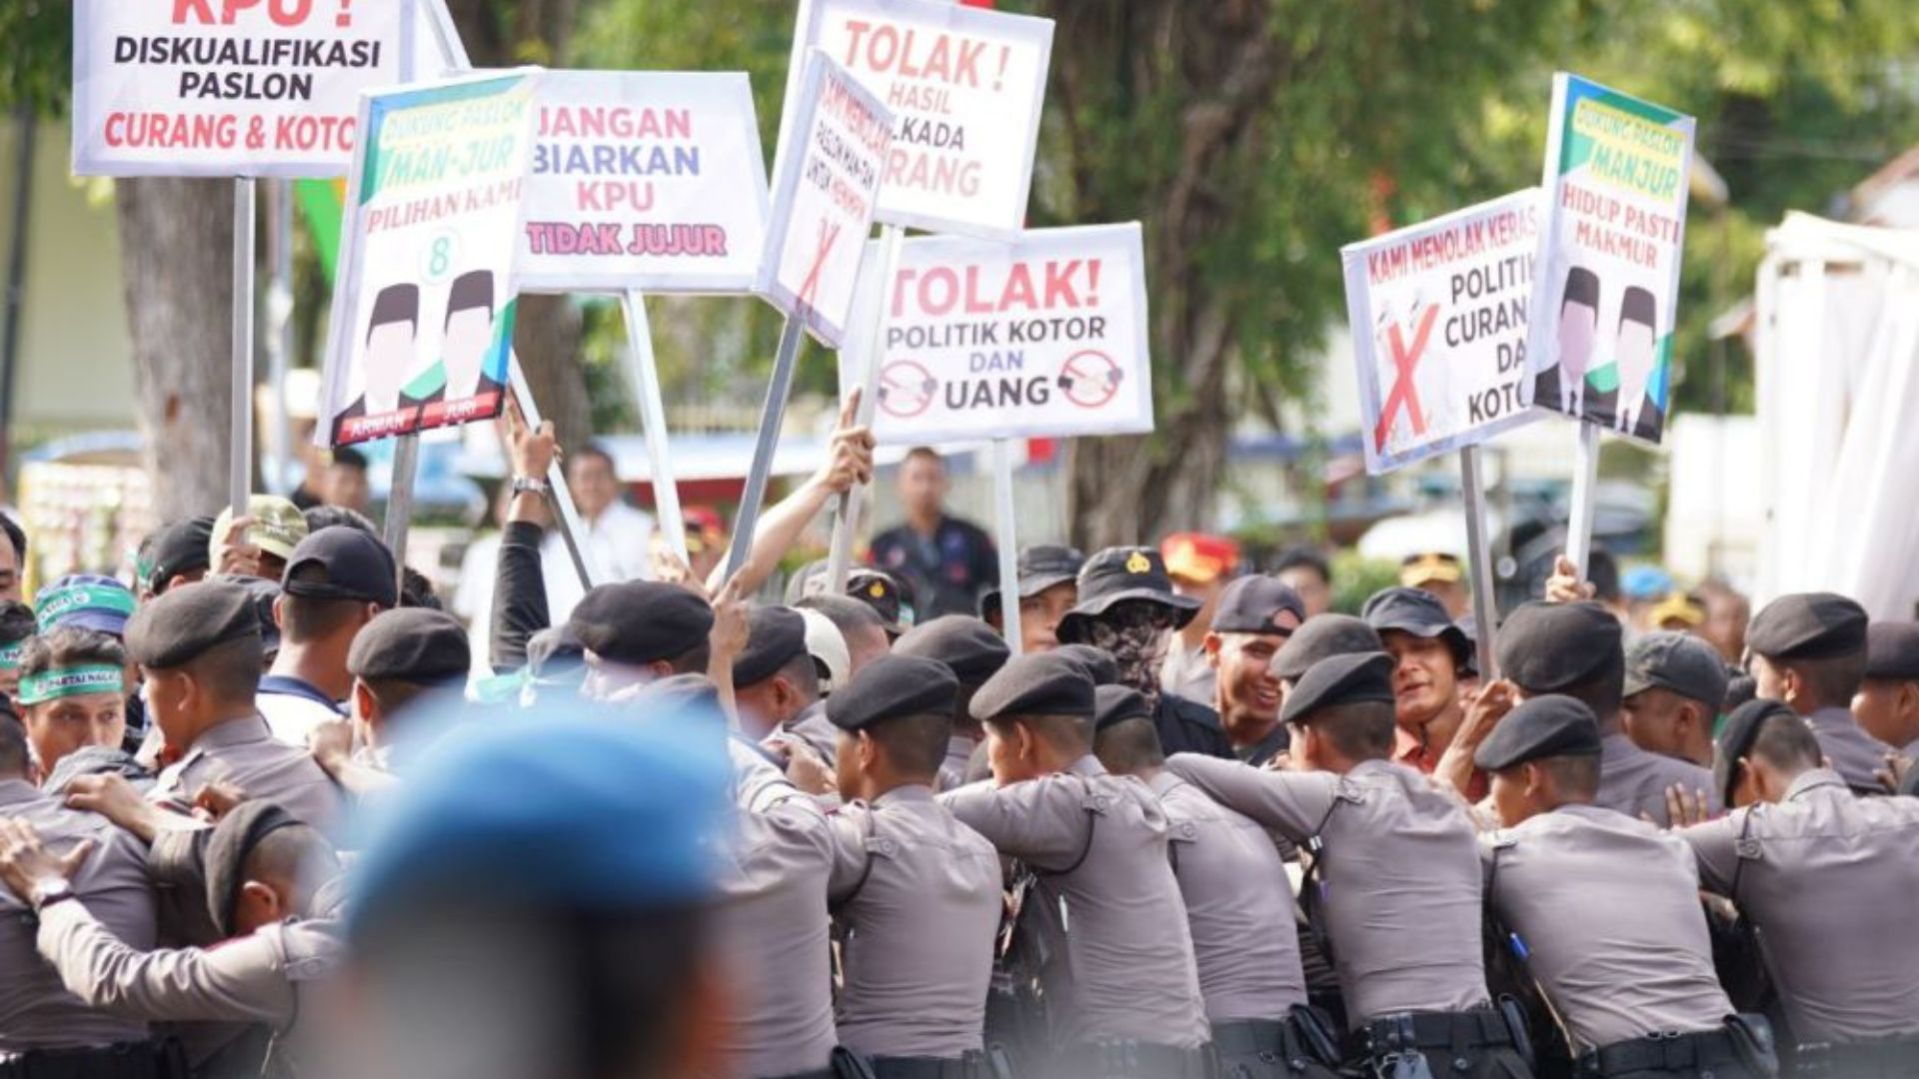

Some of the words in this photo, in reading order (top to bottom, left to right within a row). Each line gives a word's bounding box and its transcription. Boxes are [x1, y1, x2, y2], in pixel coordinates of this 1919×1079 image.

[114, 36, 380, 68] DISKUALIFIKASI
[844, 20, 986, 88] TOLAK
[993, 47, 1011, 92] !
[179, 71, 313, 100] PASLON
[888, 82, 952, 115] HASIL
[105, 112, 237, 149] CURANG
[245, 115, 265, 150] &
[537, 107, 691, 139] JANGAN
[386, 133, 515, 188] MAN-JUR
[1590, 141, 1680, 200] MANJUR
[367, 191, 460, 233] PILIHAN
[465, 177, 523, 212] KAMI
[577, 180, 655, 212] KPU
[1561, 181, 1621, 224] HIDUP
[1624, 203, 1681, 246] PASTI
[429, 236, 449, 277] 8
[526, 222, 623, 255] TIDAK
[627, 223, 728, 256] JUJUR
[1368, 244, 1408, 286] KAMI
[1410, 224, 1484, 271] MENOLAK
[1487, 205, 1537, 246] KERAS
[1576, 218, 1659, 269] MAKMUR
[891, 258, 1101, 318] TOLAK!
[887, 320, 999, 349] POLITIK
[1008, 316, 1106, 344] KOTOR
[969, 350, 1024, 374] DAN
[945, 376, 1050, 410] UANG
